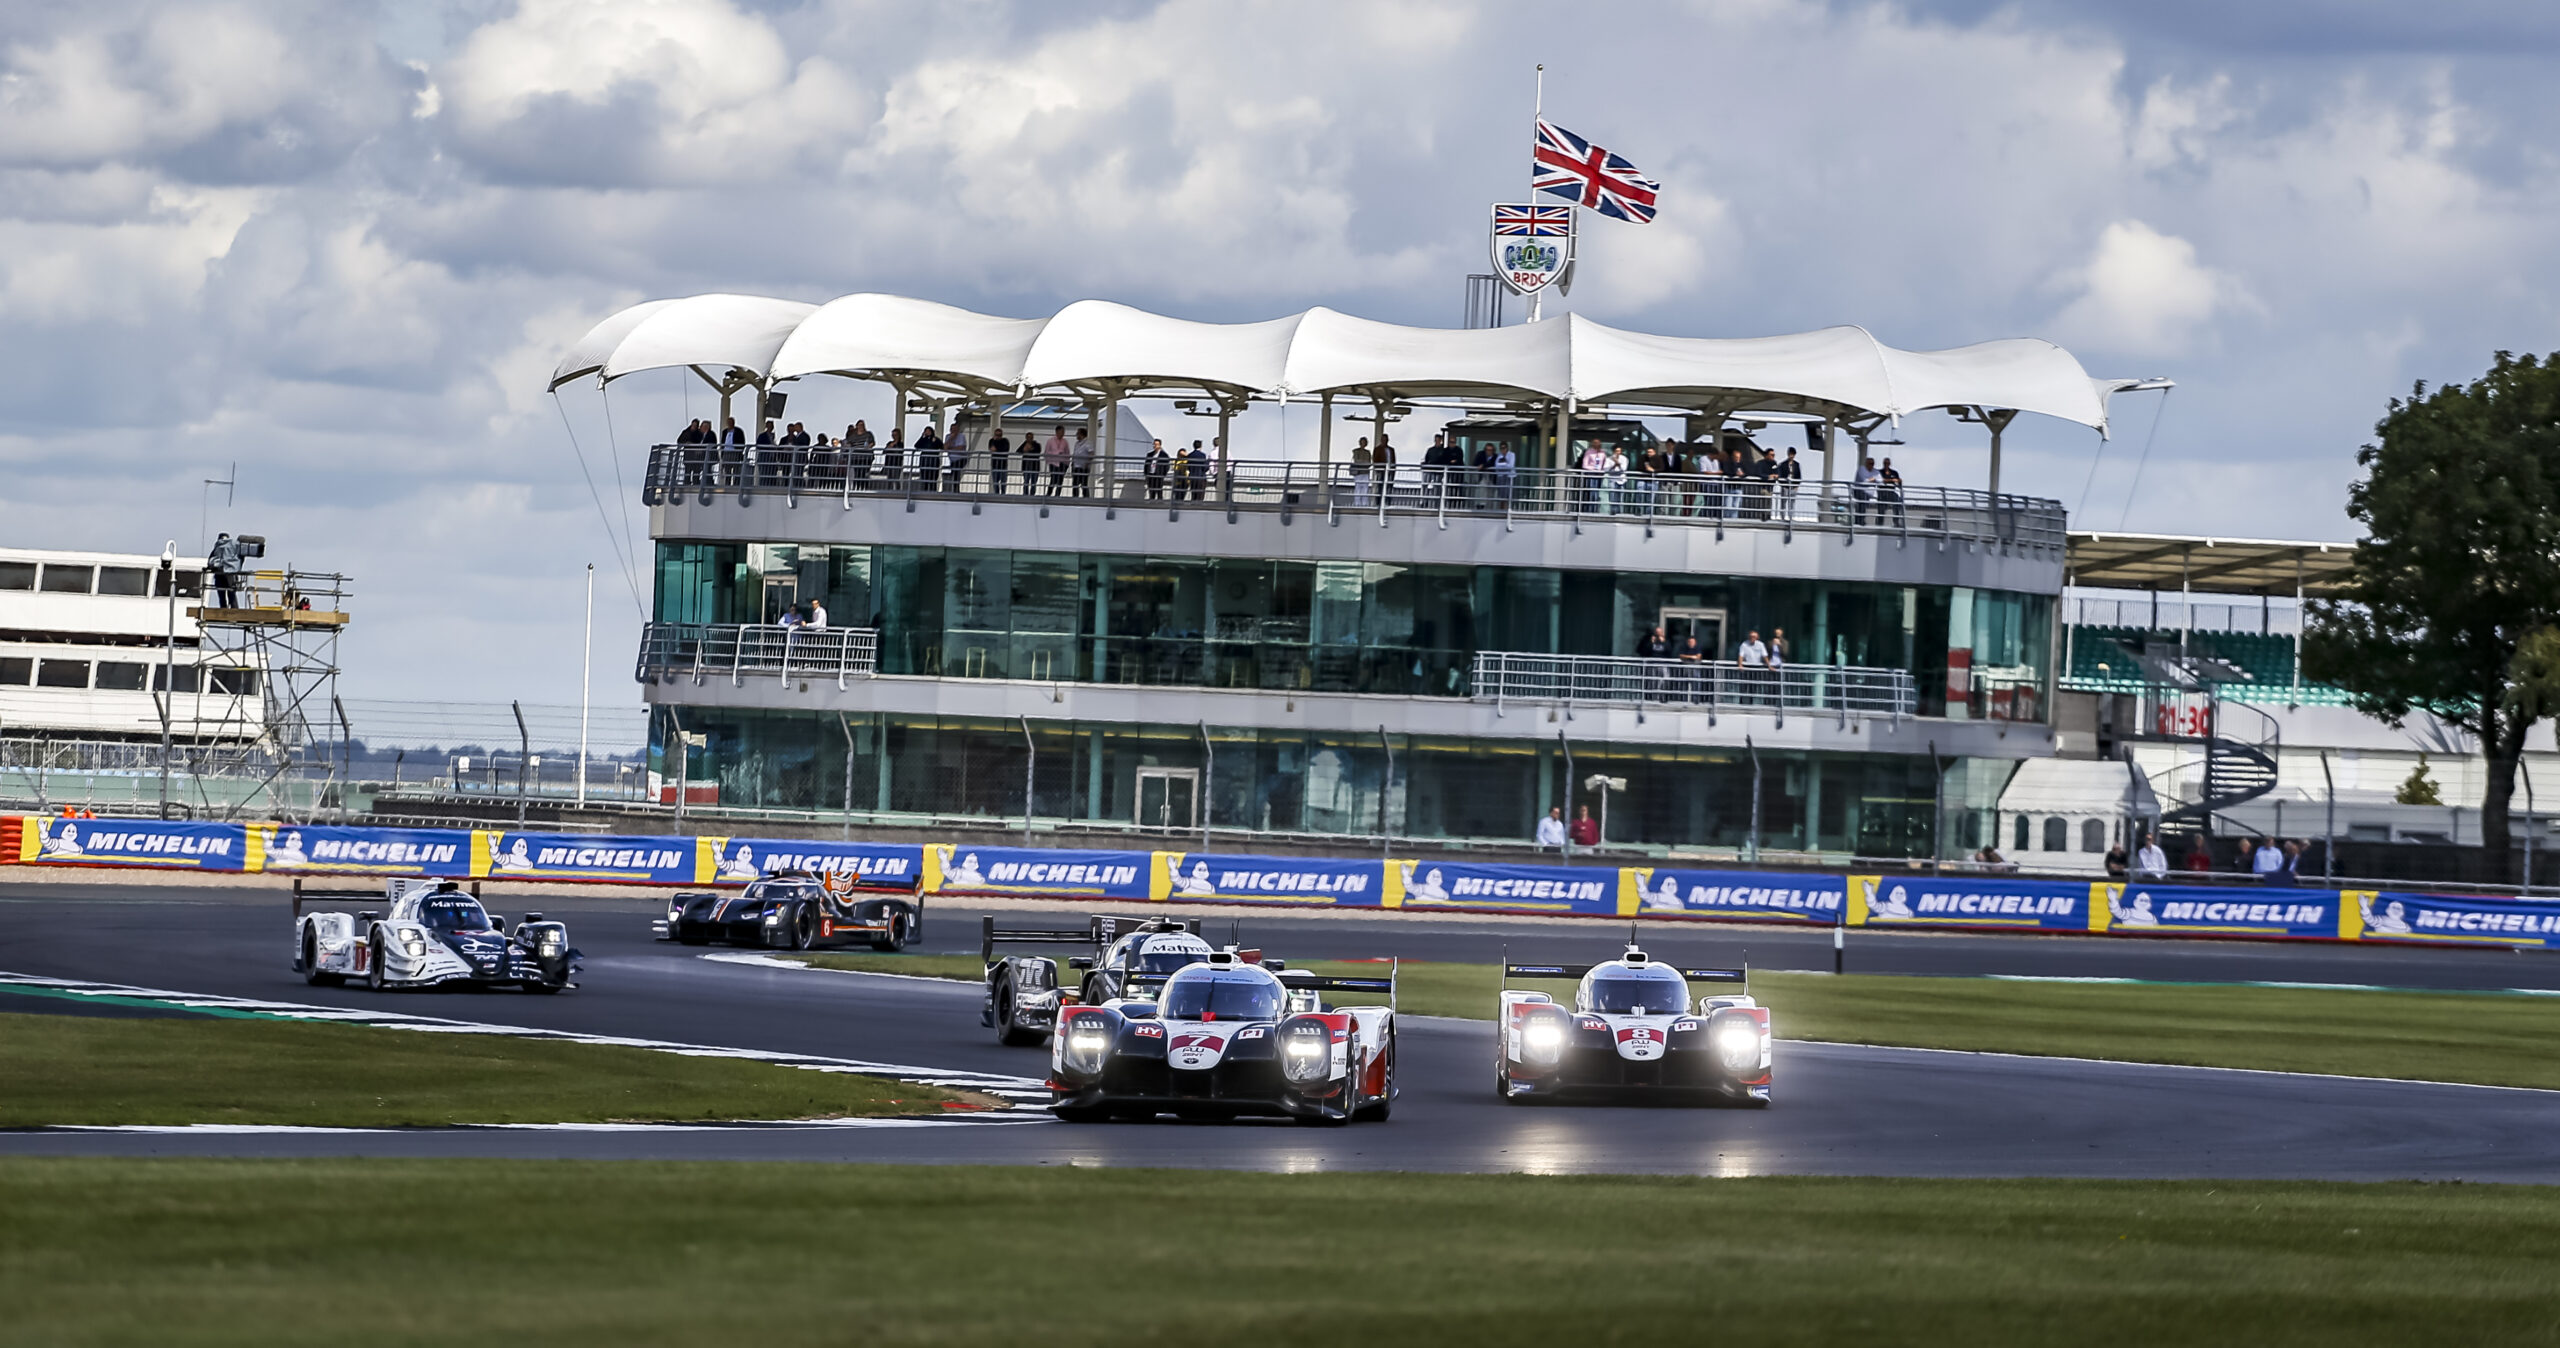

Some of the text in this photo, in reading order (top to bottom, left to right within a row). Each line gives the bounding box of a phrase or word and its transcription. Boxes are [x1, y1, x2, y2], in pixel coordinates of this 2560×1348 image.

[1513, 272, 1546, 286] BRDC
[87, 833, 231, 856] MICHELIN
[312, 840, 457, 863] MICHELIN
[538, 847, 683, 869] MICHELIN
[763, 854, 909, 875] MICHELIN
[988, 862, 1138, 885] MICHELIN
[1219, 871, 1369, 893] MICHELIN
[1452, 877, 1604, 901] MICHELIN
[1689, 886, 1842, 910] MICHELIN
[1917, 893, 2075, 915] MICHELIN
[2162, 902, 2324, 924] MICHELIN
[823, 919, 831, 937] 6
[1137, 1025, 1160, 1035] HY
[1242, 1029, 1261, 1038] P1
[1583, 1020, 1606, 1030] HY
[1631, 1028, 1651, 1039] 8
[1188, 1034, 1210, 1046] 7
